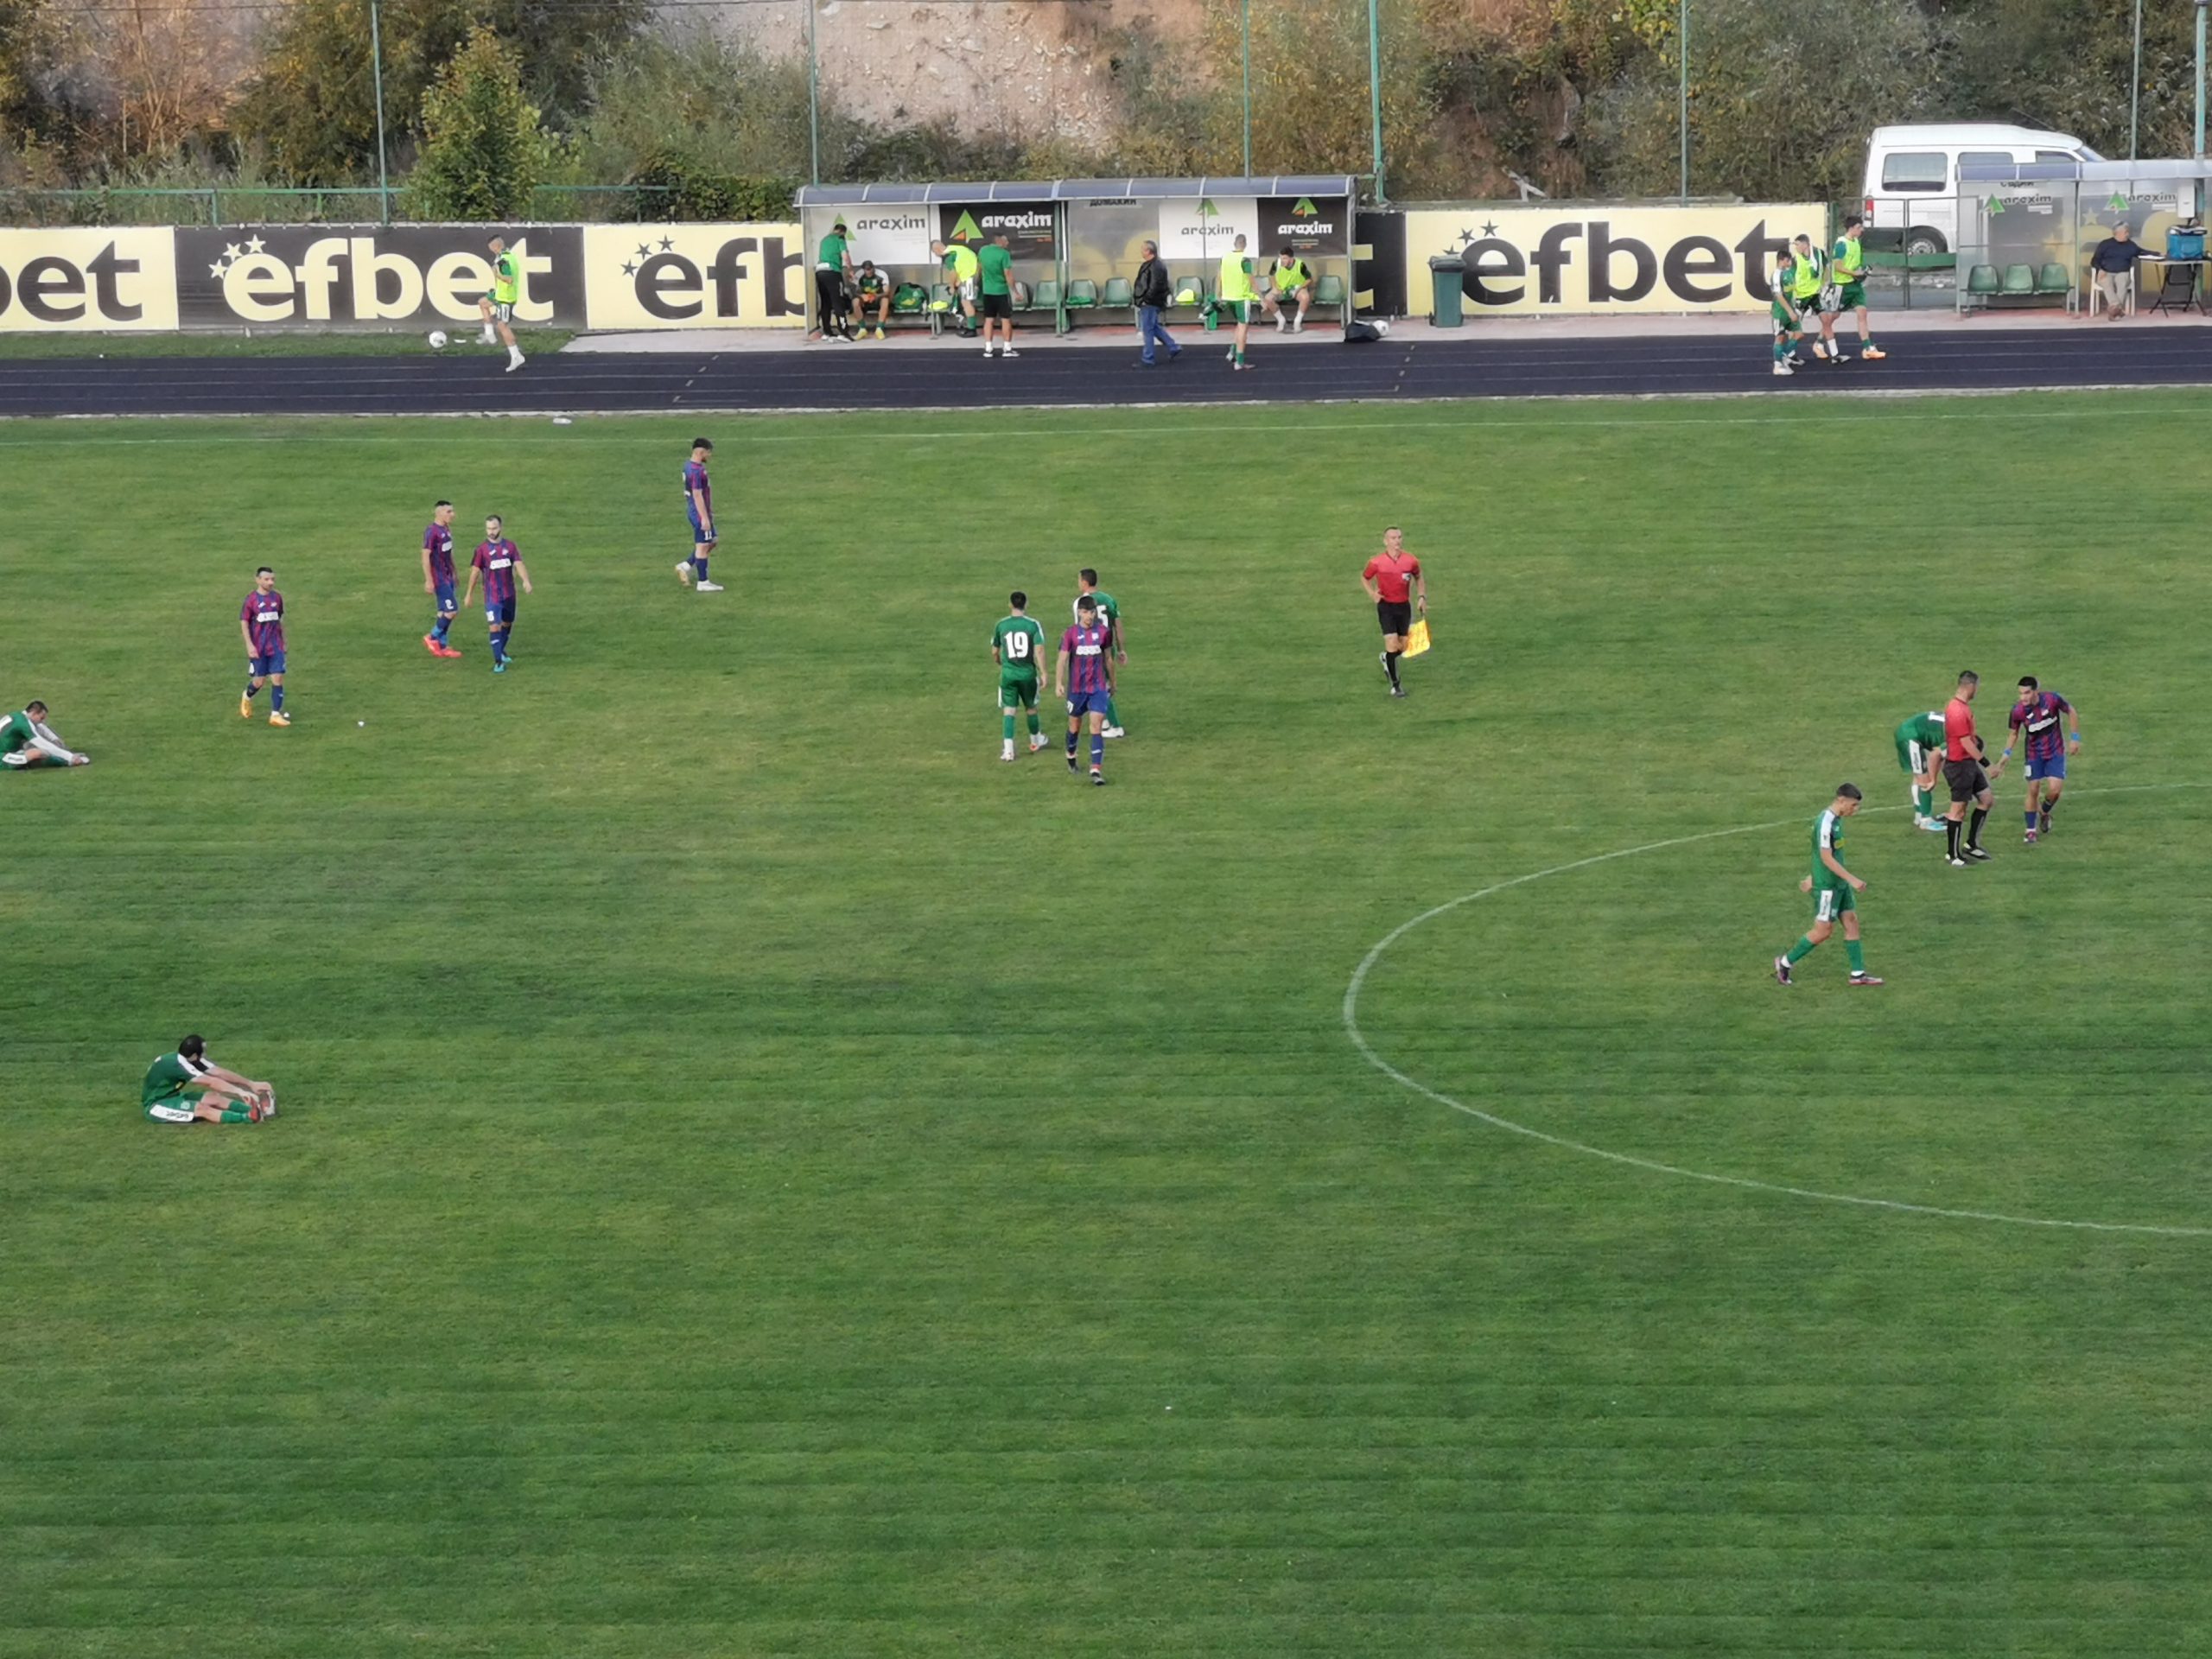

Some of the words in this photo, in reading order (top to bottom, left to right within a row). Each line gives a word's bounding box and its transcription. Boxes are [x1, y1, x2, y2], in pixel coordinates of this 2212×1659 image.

[2004, 194, 2052, 204] araxim
[2128, 192, 2177, 202] araxim
[856, 214, 926, 230] araxim
[981, 211, 1052, 228] araxim
[1180, 223, 1234, 236] araxim
[1277, 221, 1333, 235] araxim
[1460, 219, 1790, 306] efbet
[0, 240, 143, 322] et
[222, 237, 554, 321] efbet
[1004, 631, 1029, 658] 19
